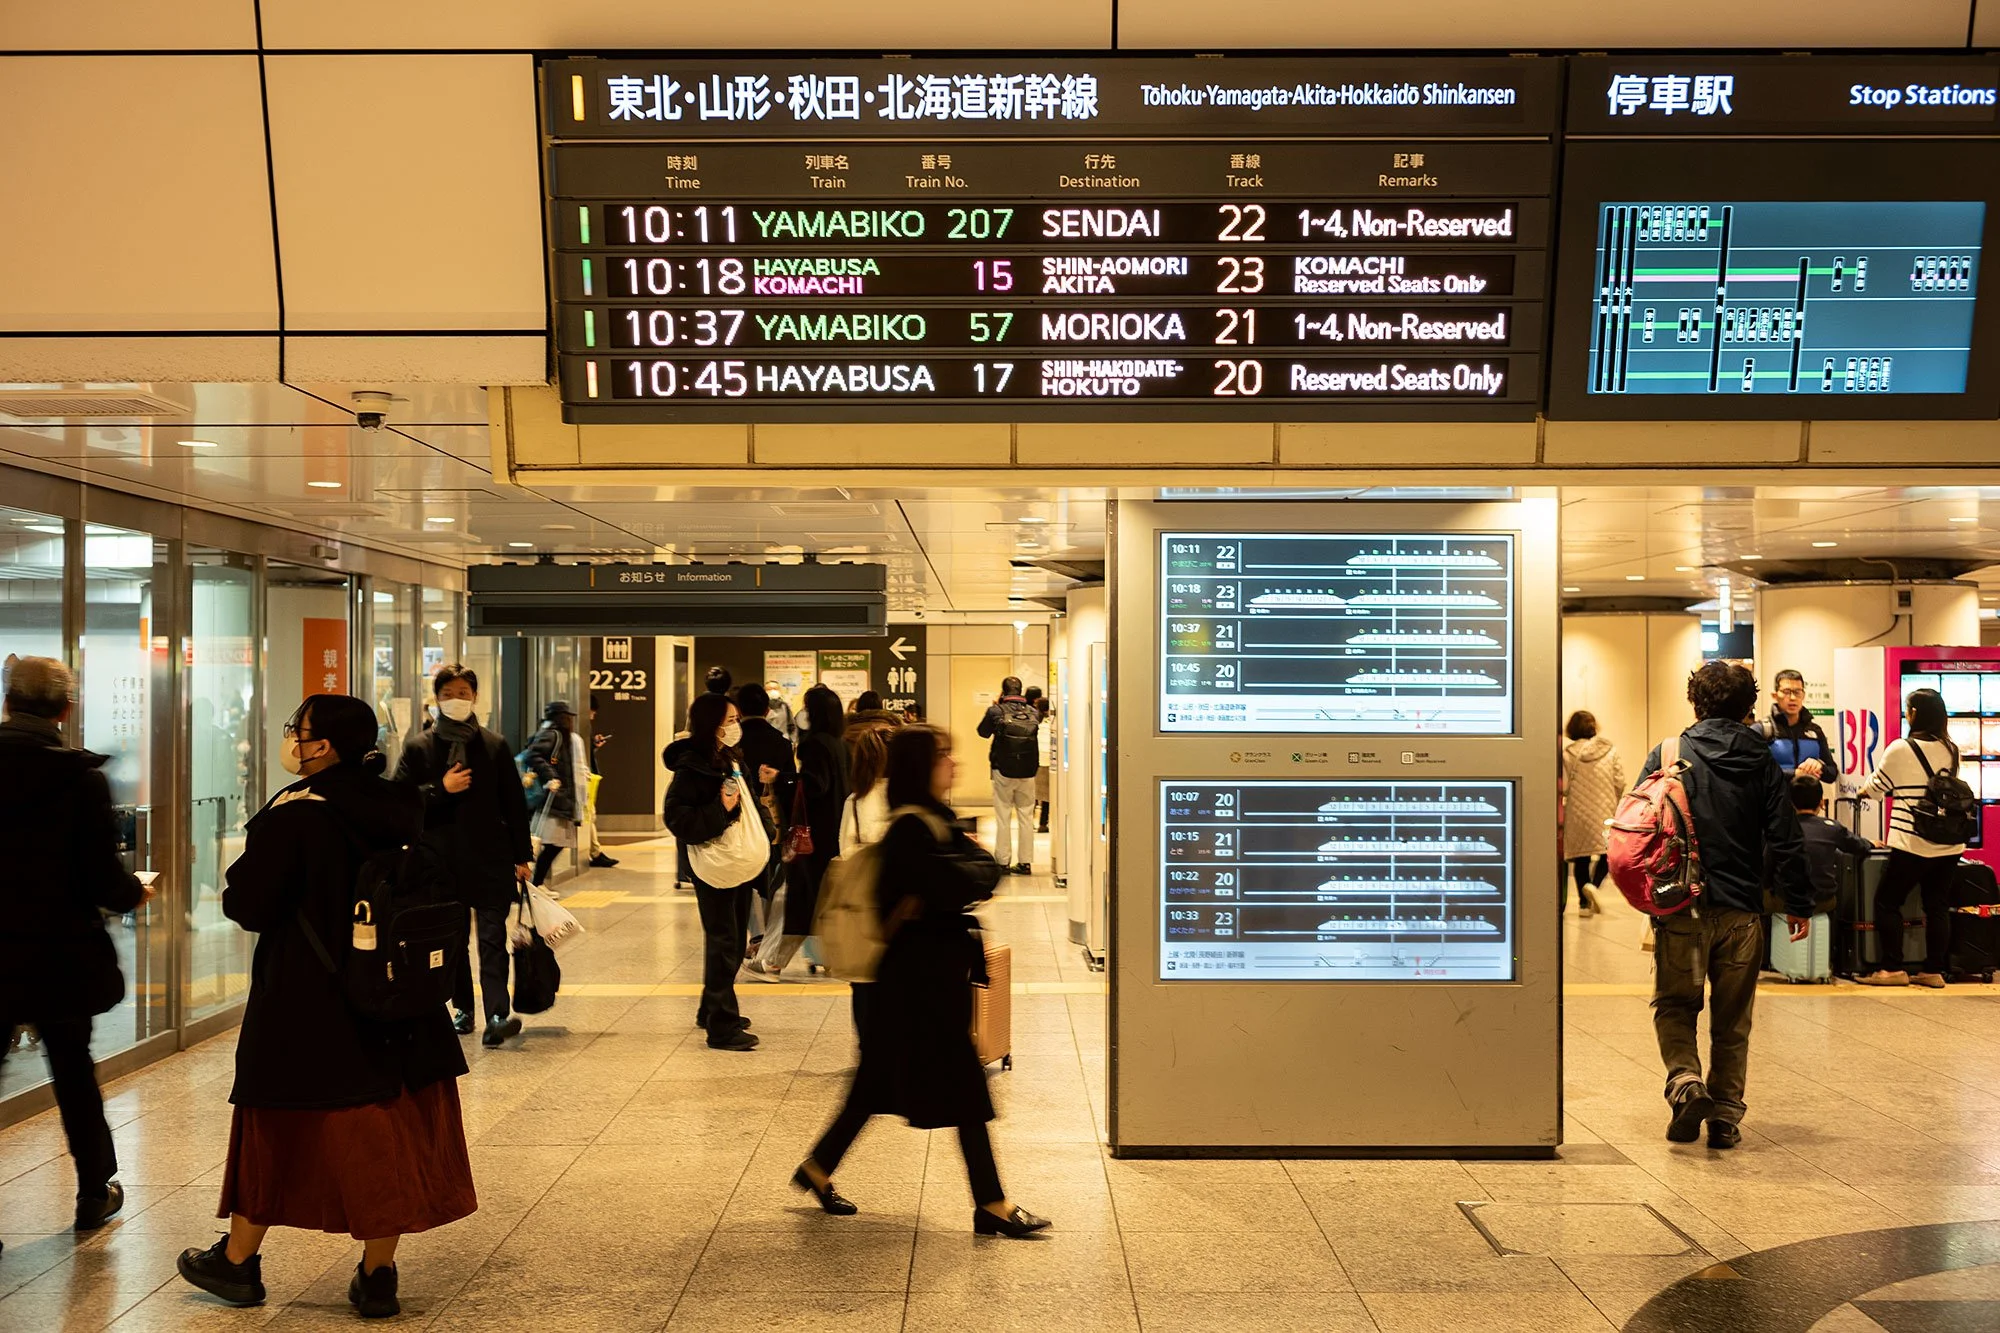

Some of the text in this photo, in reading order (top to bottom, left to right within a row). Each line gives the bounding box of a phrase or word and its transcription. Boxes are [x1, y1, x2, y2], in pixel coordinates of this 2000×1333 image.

[1422, 82, 1516, 105] Shinkansen
[1606, 74, 1734, 116] 停車駅
[1849, 84, 1997, 110] Stop Stations
[667, 155, 697, 171] 時刻
[805, 154, 849, 170] 列車名
[921, 154, 952, 170] 番号
[1084, 154, 1116, 170] 行先
[1230, 153, 1261, 169] 番線
[1393, 153, 1425, 169] 記事
[664, 176, 701, 189] Time
[810, 175, 846, 189] Train
[905, 175, 969, 188] Train No.
[1059, 174, 1140, 188] Destination
[1225, 174, 1264, 188] Track
[1378, 173, 1438, 187] Remarks
[621, 205, 736, 243] 10:11
[752, 210, 925, 238] YAMABIKO
[947, 208, 1014, 239] 207
[1042, 209, 1160, 238] SENDAI
[1217, 204, 1266, 242] 22
[1352, 208, 1513, 237] Non-Reserved
[624, 256, 1405, 295] 10:18 HAYABUSA 15 SHIN-AOMORI 23 KOMACHI
[754, 274, 1487, 295] KOMACHI AKITA Reserved Seats Only
[626, 309, 745, 346] 10:37
[755, 314, 926, 341] YAMABIKO
[970, 312, 1014, 342] 57
[1041, 313, 1186, 341] MORIOKA
[1215, 308, 1255, 345] 21
[1347, 312, 1506, 340] Non-Reserved
[628, 359, 1504, 397] 10:45 HAYABUSA 17 SHIN-HAKODATE- 20 Reserved Seats Only
[1041, 377, 1141, 396] HOKUTO
[1172, 544, 1236, 559] 10:11 22
[619, 571, 666, 583] お知らせ
[677, 572, 732, 582] Information
[1172, 584, 1235, 599] 10:18 23
[1171, 624, 1233, 638] 10:37 21
[1171, 663, 1235, 678] 10:45 20
[1838, 709, 1879, 776] BR
[1170, 792, 1234, 806] 10:07 20
[1170, 832, 1232, 846] 10:15 21
[1170, 871, 1234, 886] 10:22 20
[1170, 911, 1233, 925] 10:33 23
